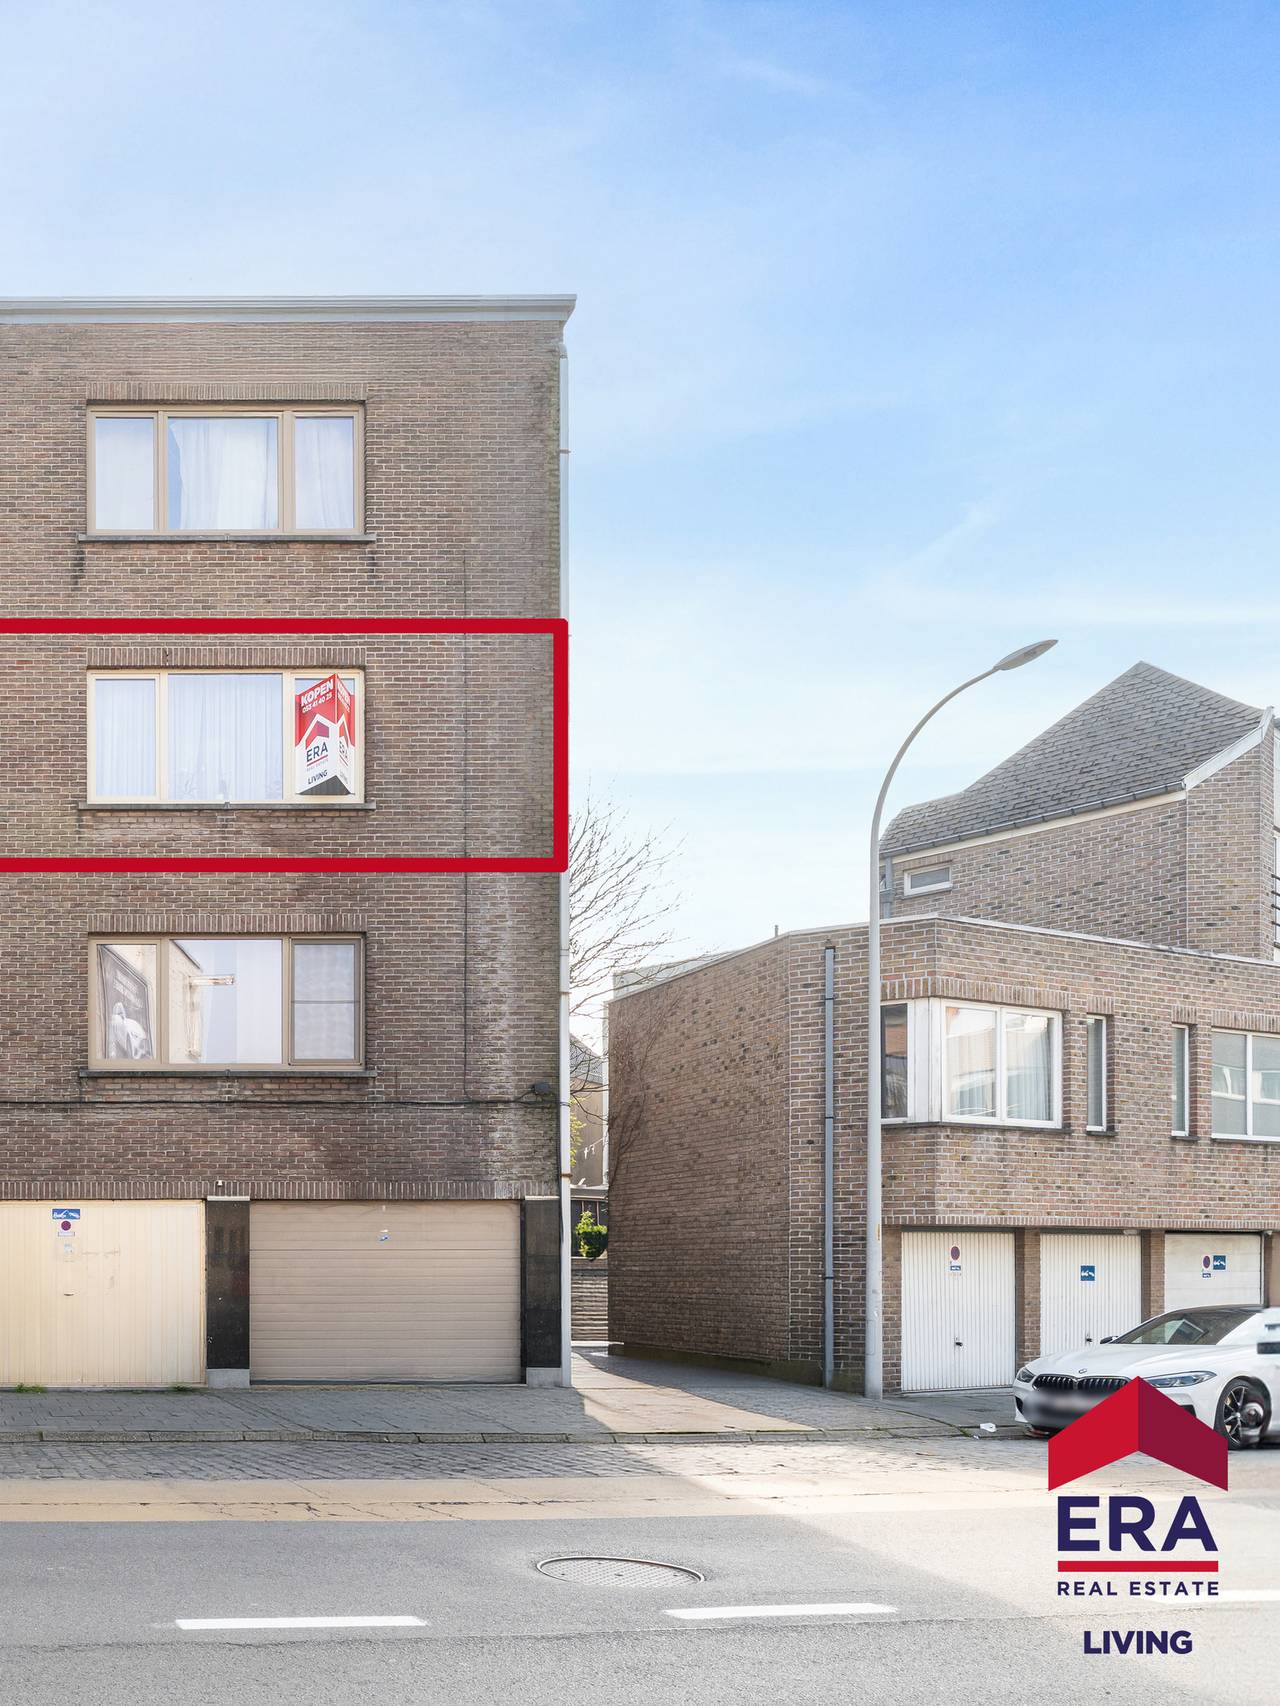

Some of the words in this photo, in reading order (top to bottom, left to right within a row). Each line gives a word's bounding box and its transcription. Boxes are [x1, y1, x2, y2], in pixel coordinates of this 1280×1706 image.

[301, 678, 334, 707] KOPEN
[306, 741, 328, 762] ERA
[307, 769, 328, 784] LIVING
